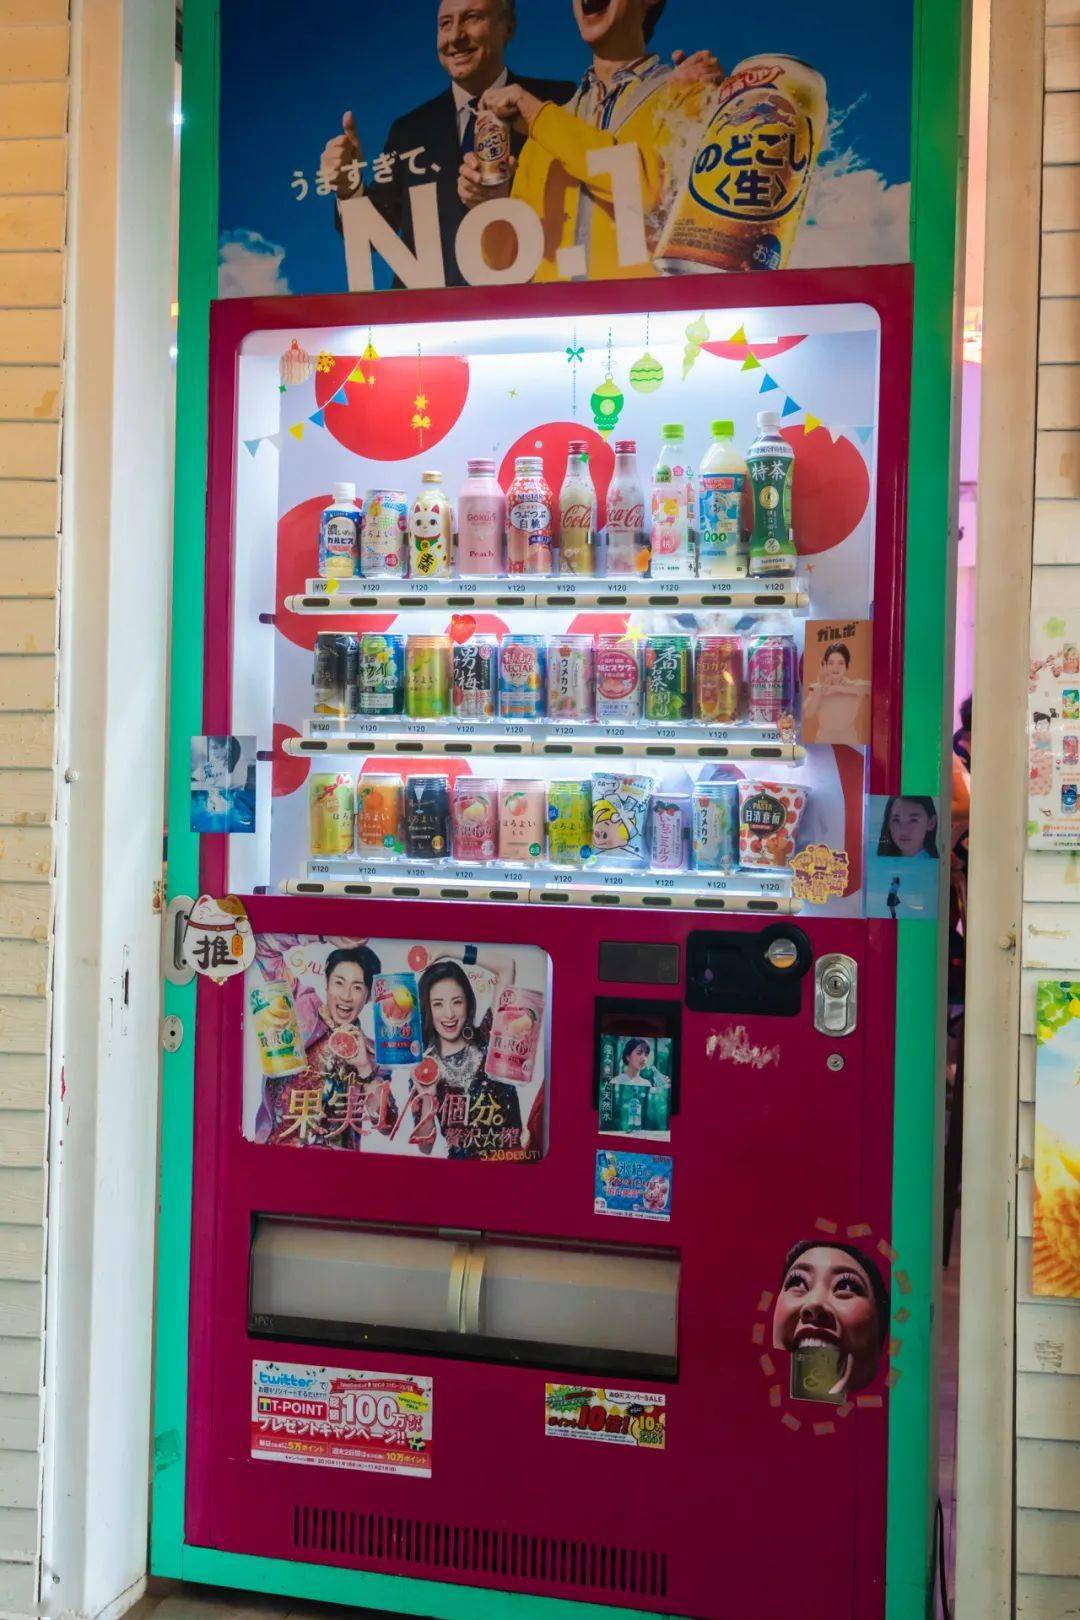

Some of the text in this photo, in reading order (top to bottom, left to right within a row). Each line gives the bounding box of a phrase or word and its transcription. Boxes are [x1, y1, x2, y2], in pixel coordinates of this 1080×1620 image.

[694, 134, 807, 175] のどごし
[289, 145, 442, 201] うますぎて、
[339, 141, 650, 292] No.1
[751, 460, 786, 482] 特茶
[514, 510, 546, 520] つぶつぶ
[519, 519, 541, 529] 白桃
[703, 530, 728, 543] Qoo
[315, 583, 327, 592] ¥12
[362, 583, 380, 592] ¥120
[410, 583, 428, 592] ¥120
[459, 583, 477, 592] ¥120
[508, 583, 526, 592] ¥120
[557, 583, 576, 592] ¥120
[608, 583, 627, 592] ¥120
[660, 583, 679, 592] ¥120
[712, 583, 731, 592] ¥120
[765, 583, 785, 592] ¥120
[817, 621, 860, 642] ガルボ
[458, 644, 480, 691] 男梅
[653, 645, 682, 681] 香る
[560, 658, 569, 695] ウメカク
[360, 724, 377, 732] ¥120
[457, 725, 475, 733] ¥120
[555, 727, 574, 735] ¥120
[606, 728, 625, 736] ¥120
[657, 729, 676, 738] ¥120
[709, 730, 728, 739] ¥120
[503, 819, 536, 828] ほろよい
[700, 808, 708, 845] ウメカク
[312, 865, 329, 873] ¥120
[359, 866, 377, 875] ¥120
[407, 868, 425, 877] ¥120
[455, 871, 474, 879] ¥120
[504, 872, 523, 881] ¥120
[554, 875, 573, 883] ¥120
[604, 876, 623, 885] ¥120
[655, 879, 675, 888] ¥120
[707, 880, 727, 890] ¥120
[760, 882, 780, 891] ¥120
[192, 935, 239, 970] 推
[258, 1371, 312, 1388] twitter
[271, 1399, 324, 1417] T-POINT
